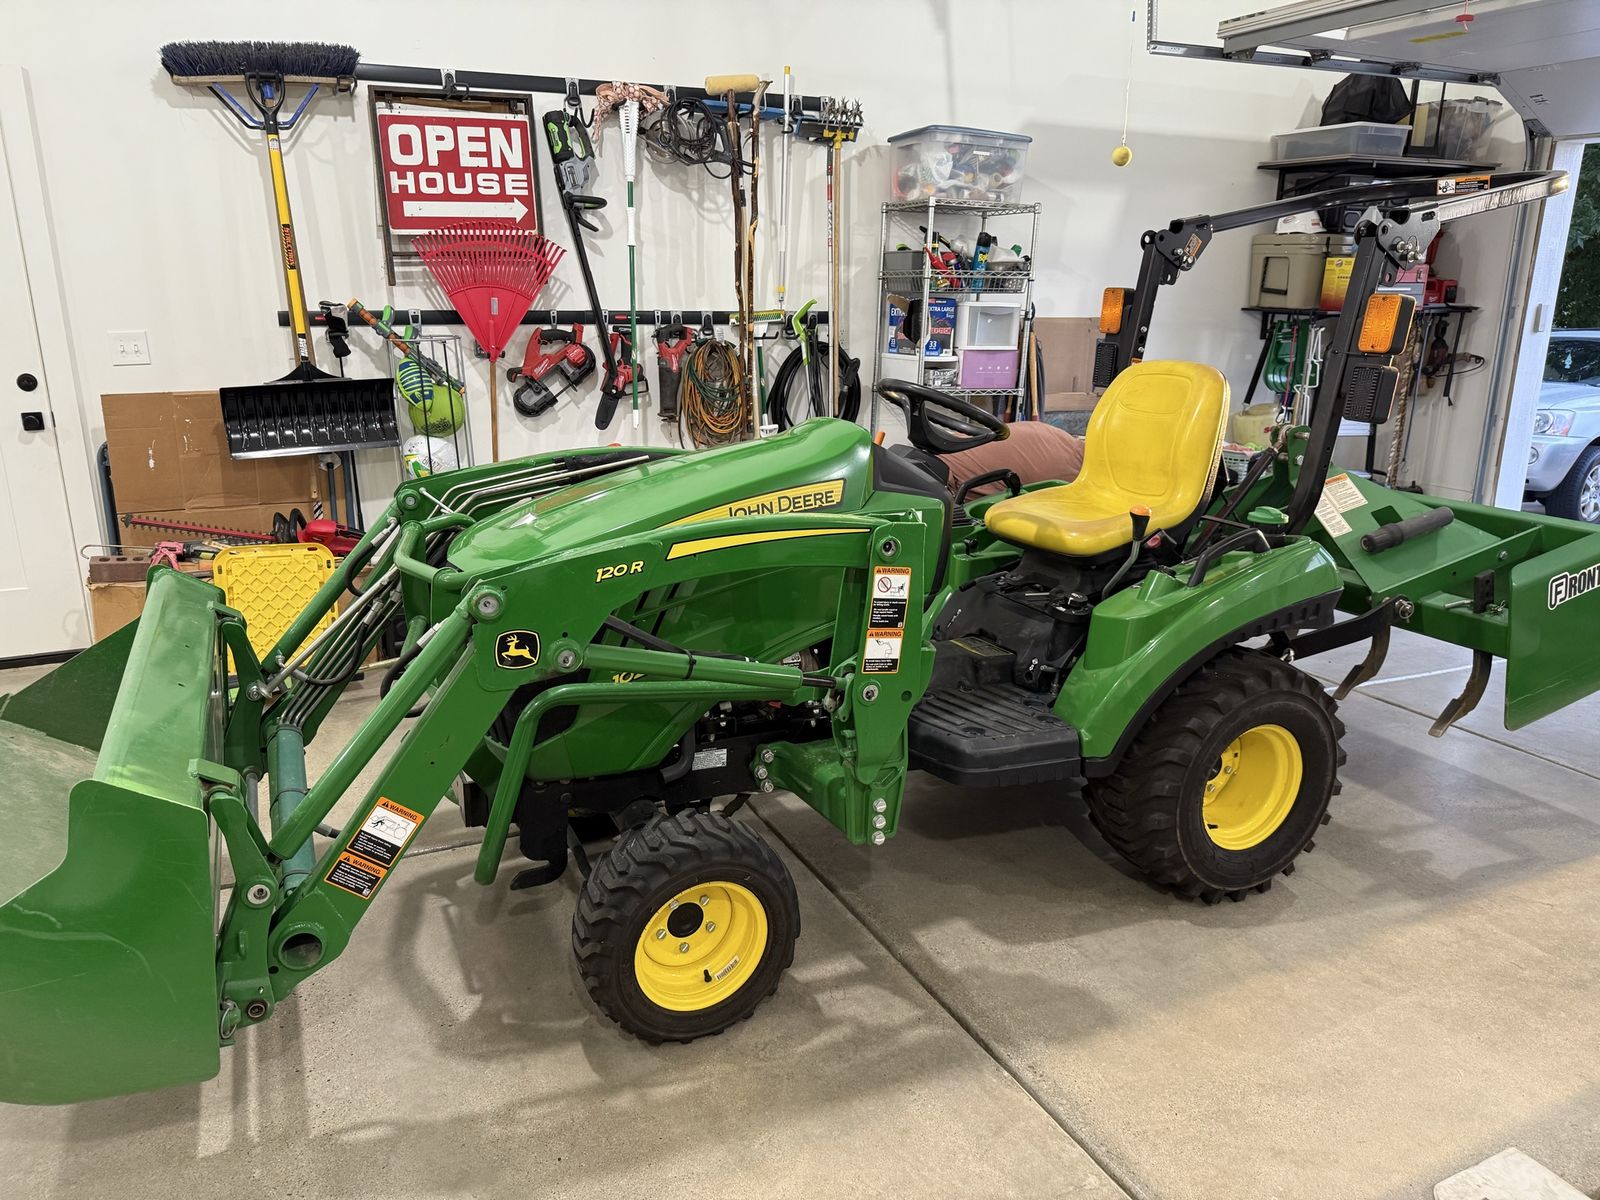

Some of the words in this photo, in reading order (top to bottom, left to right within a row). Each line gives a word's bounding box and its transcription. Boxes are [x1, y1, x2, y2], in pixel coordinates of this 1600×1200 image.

[387, 123, 524, 169] OPEN
[389, 171, 529, 196] HOUSE
[728, 500, 774, 518] JOHN
[777, 490, 835, 513] DEERE
[881, 567, 910, 575] WARNING
[389, 803, 418, 821] WARNING
[352, 858, 381, 875] WARNING
